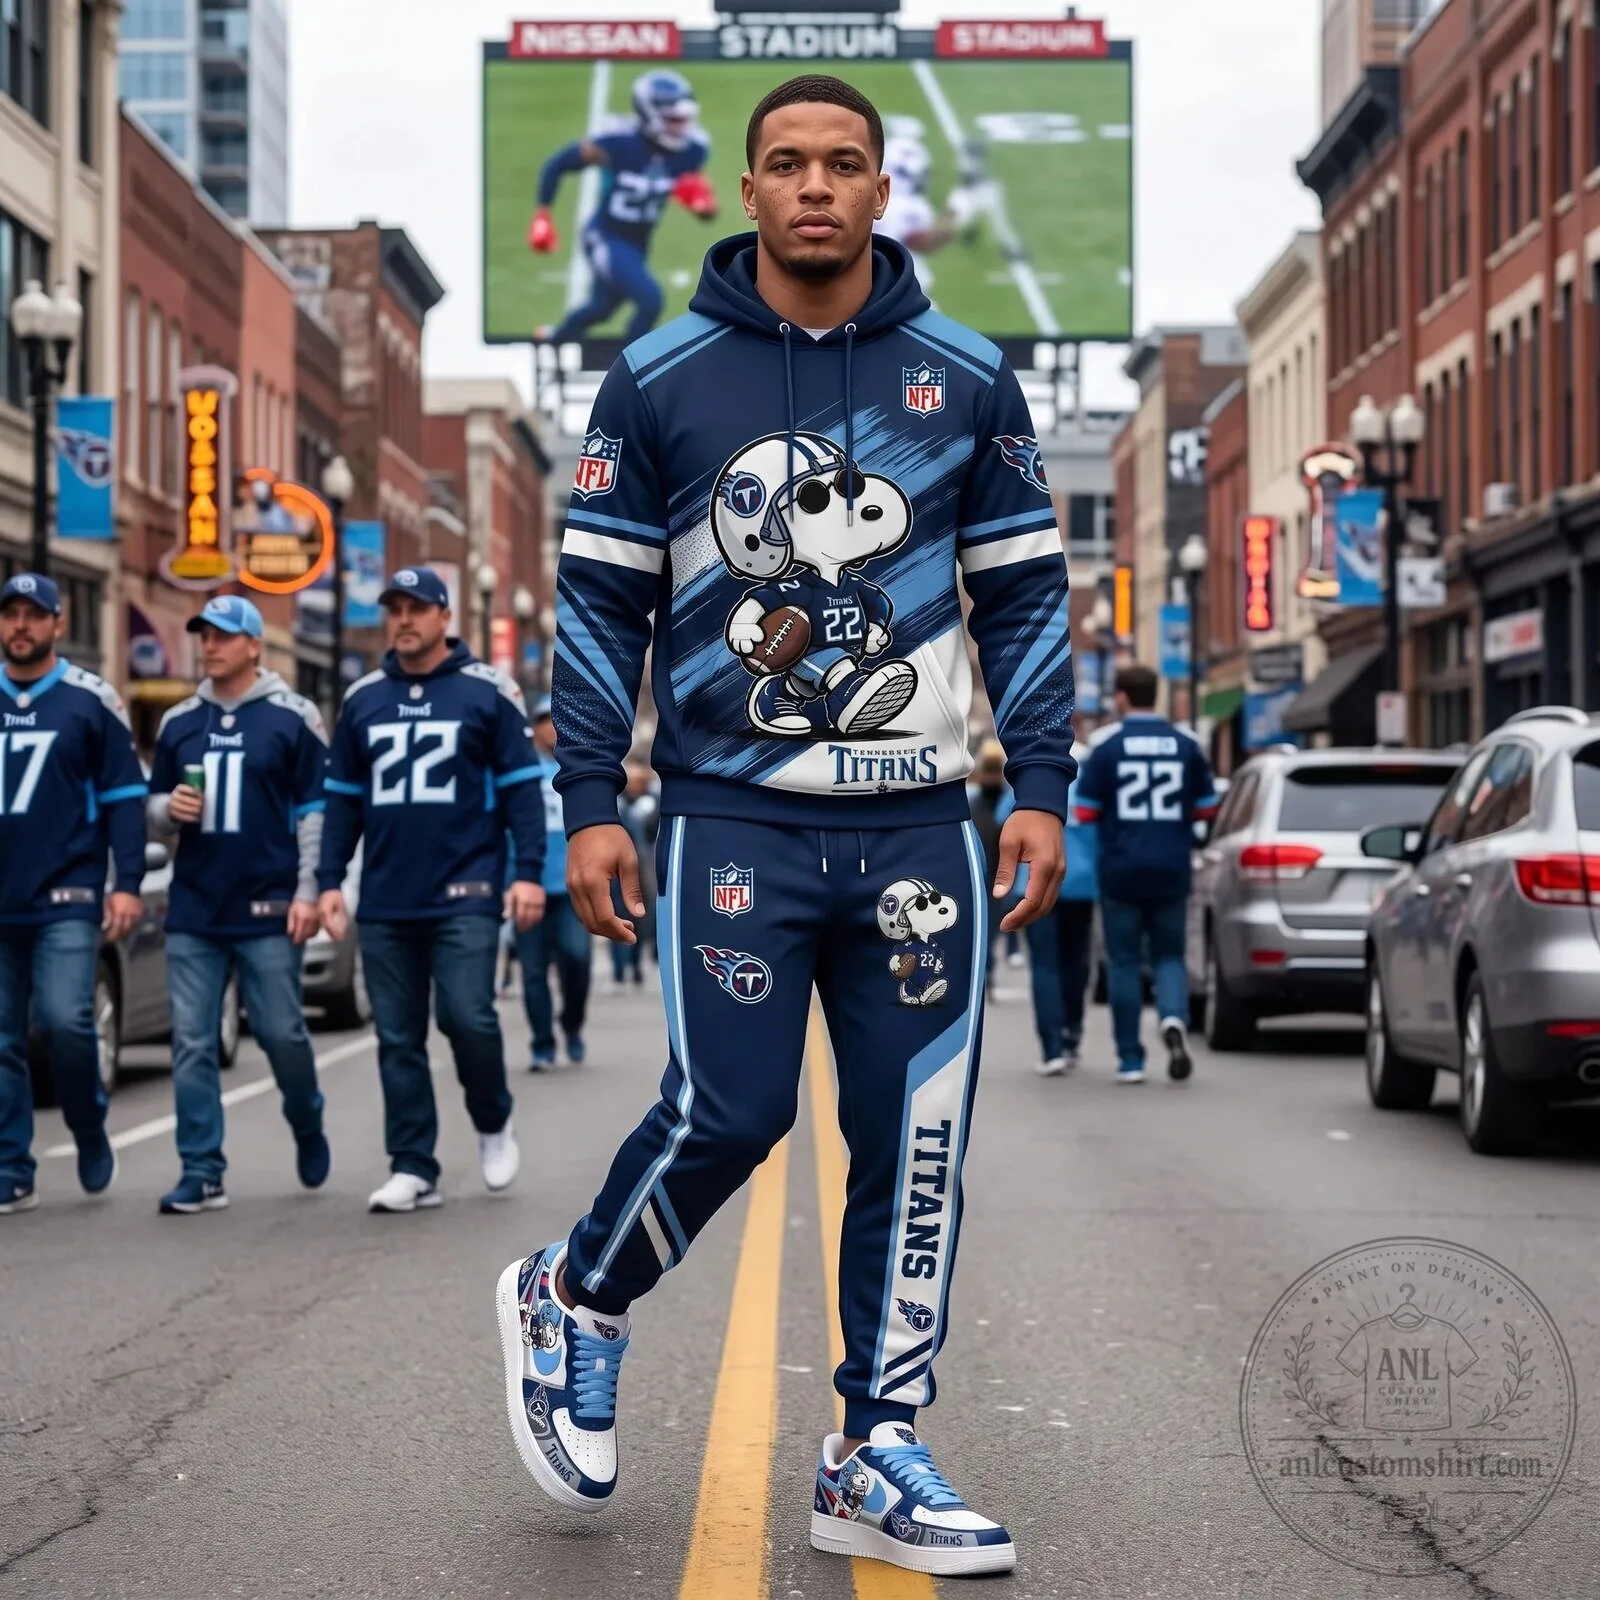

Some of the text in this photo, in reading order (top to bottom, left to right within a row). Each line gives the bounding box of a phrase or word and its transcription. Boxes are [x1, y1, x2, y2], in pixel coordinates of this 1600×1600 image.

[521, 24, 668, 54] NISSAN
[719, 26, 897, 57] STADIUM
[953, 25, 1096, 53] STADIUM
[908, 386, 941, 411] NFL
[823, 607, 862, 642] 22
[367, 720, 462, 807] 22
[828, 744, 938, 786] TITANS
[202, 751, 246, 834] 11
[1117, 760, 1184, 821] 22
[715, 886, 749, 911] NFL
[920, 953, 935, 967] 22
[901, 1119, 951, 1280] TITANS
[929, 1531, 963, 1546] TITANS
